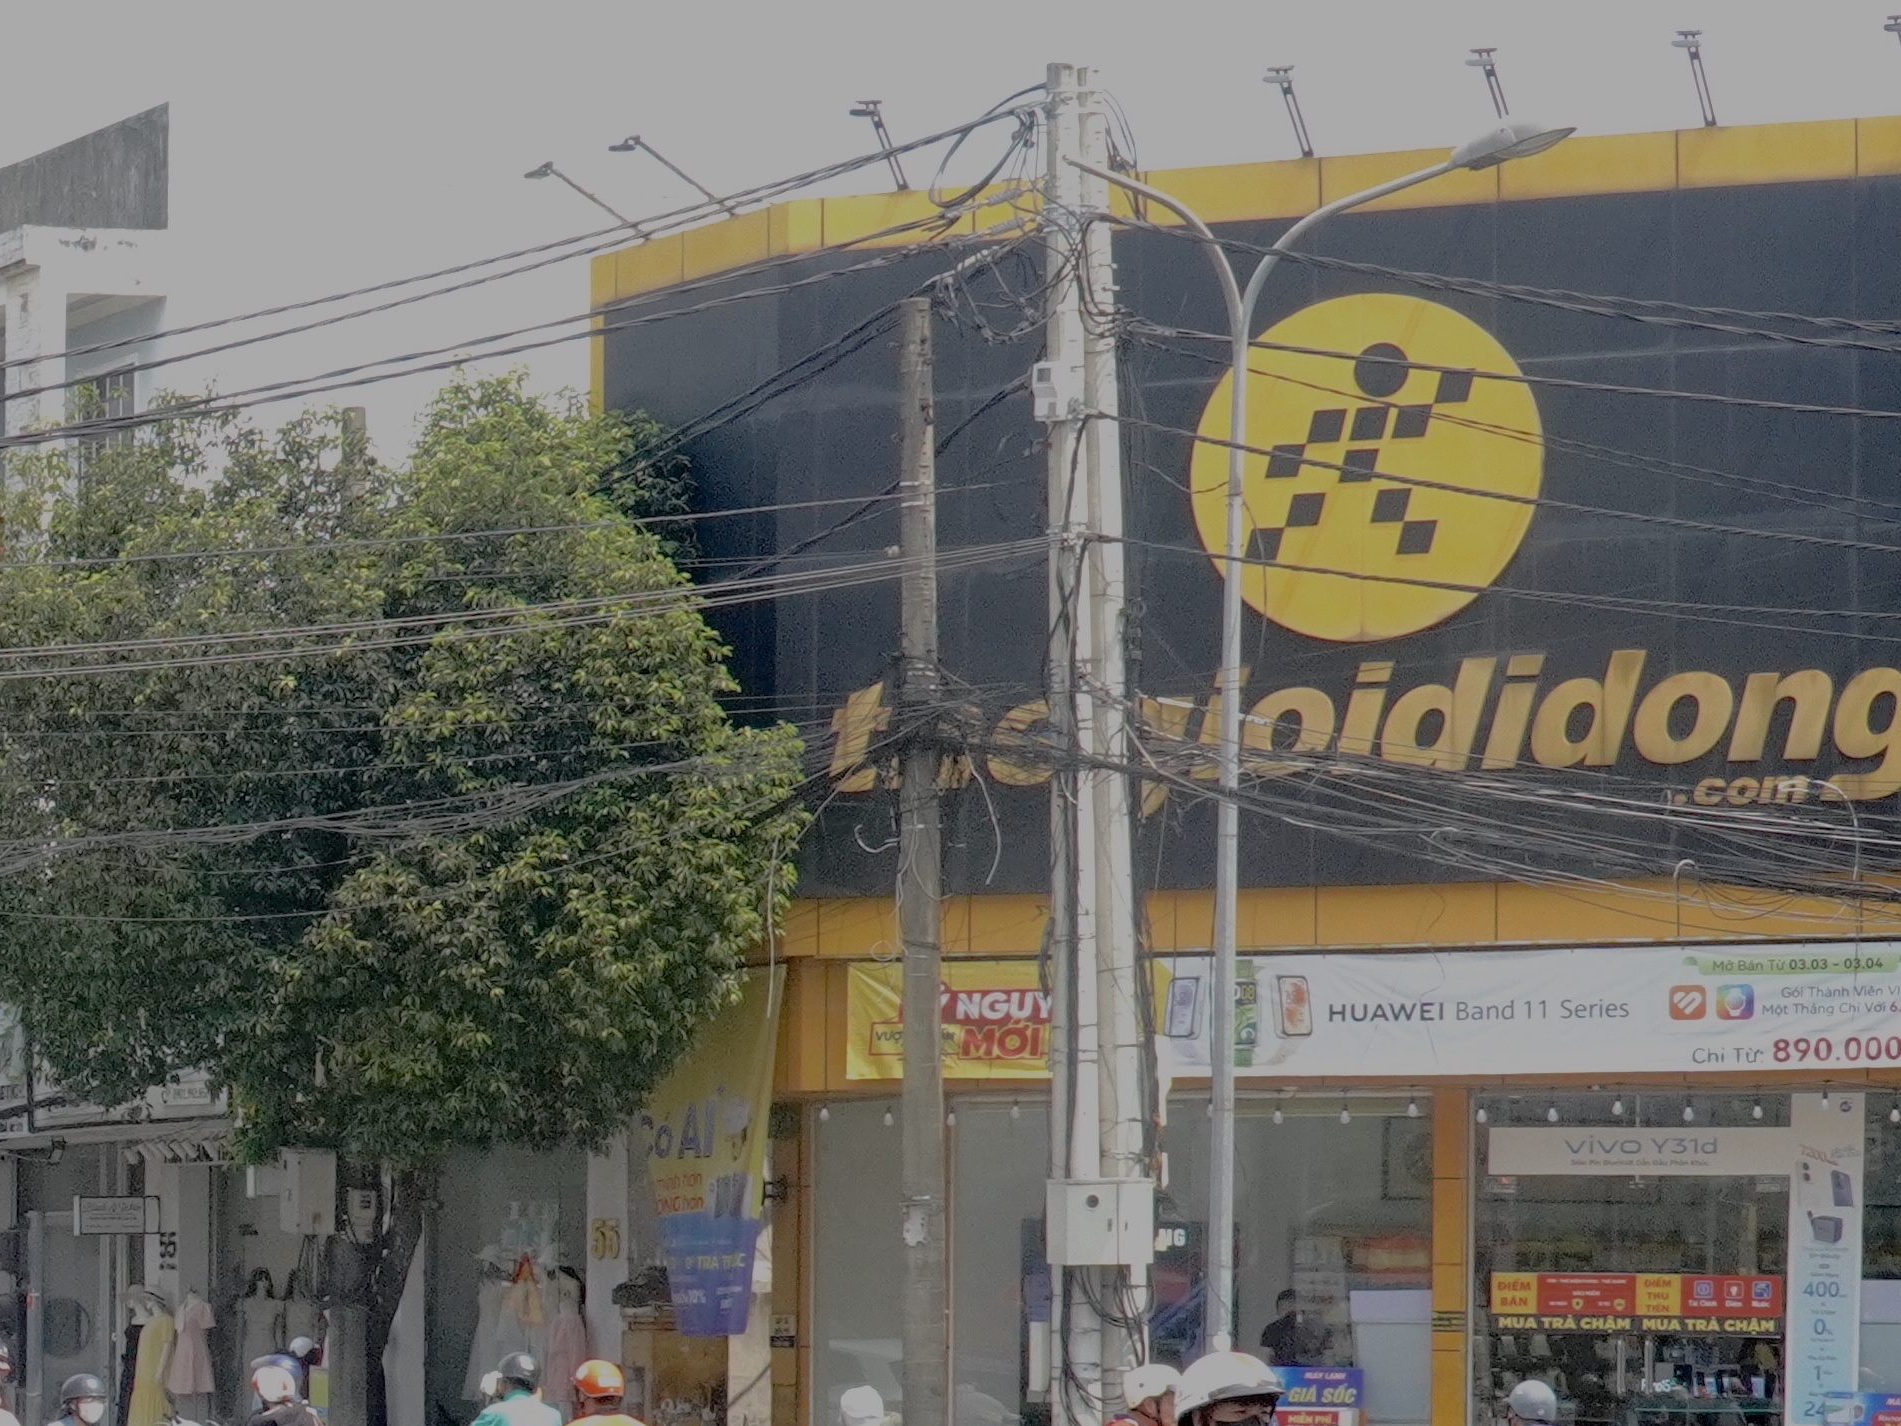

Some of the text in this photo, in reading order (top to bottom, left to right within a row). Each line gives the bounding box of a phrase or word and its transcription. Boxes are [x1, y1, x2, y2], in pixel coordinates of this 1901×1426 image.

[1789, 958, 1828, 970] 03.03
[1844, 957, 1884, 970] 03.04
[956, 991, 1052, 1020] NGUY
[1328, 999, 1630, 1022] HUAWEI Band 11 Series
[1762, 1003, 1788, 1017] Một
[876, 1030, 902, 1045] VƯỢ
[961, 1018, 1041, 1058] MỚI
[1772, 1036, 1901, 1062] 890.000
[678, 1099, 715, 1159] AI
[1565, 1135, 1718, 1155] vivo Y31d
[1803, 1281, 1839, 1297] 400
[1499, 1314, 1632, 1333] MUA TRẢ CHẬM
[1642, 1316, 1775, 1335] MUA TRẢ CHẬM
[1288, 1383, 1357, 1404] GIÁ SỐC
